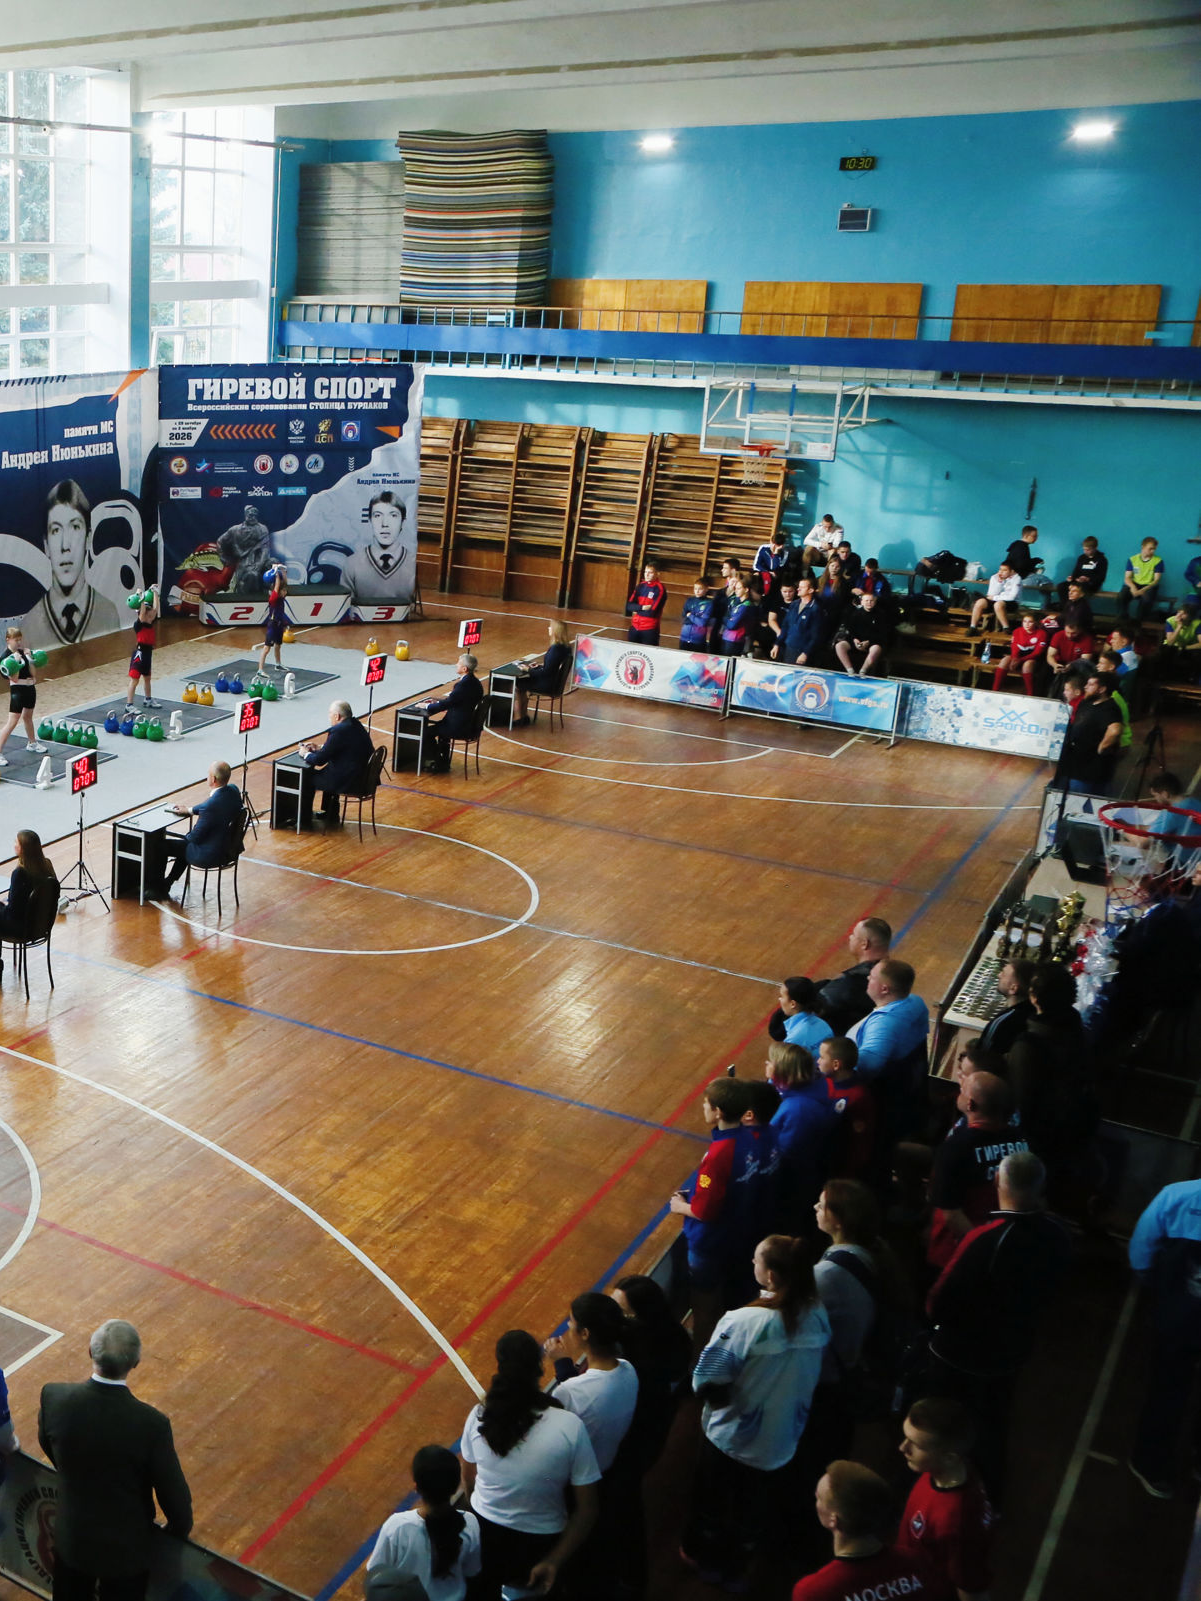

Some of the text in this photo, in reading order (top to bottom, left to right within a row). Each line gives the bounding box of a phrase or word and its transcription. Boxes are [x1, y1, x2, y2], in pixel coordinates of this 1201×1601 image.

[187, 372, 397, 400] ГИРЕВОЙ СПОРТ
[187, 402, 249, 413] Всероссийские
[309, 401, 345, 411] СТОЛИЦА
[347, 401, 389, 410] БУРЛАКОВ
[64, 420, 113, 439] памяти МС
[168, 432, 192, 441] 2026
[1, 441, 114, 471] Андрея Нюнькина
[229, 606, 255, 620] 2
[310, 603, 323, 617] 1
[372, 607, 396, 620] 3
[169, 709, 183, 736] 5
[240, 715, 259, 731] 0707
[982, 717, 1050, 737] SportOn
[35, 755, 54, 787] 4
[75, 756, 89, 775] 40
[73, 770, 95, 791] 0707
